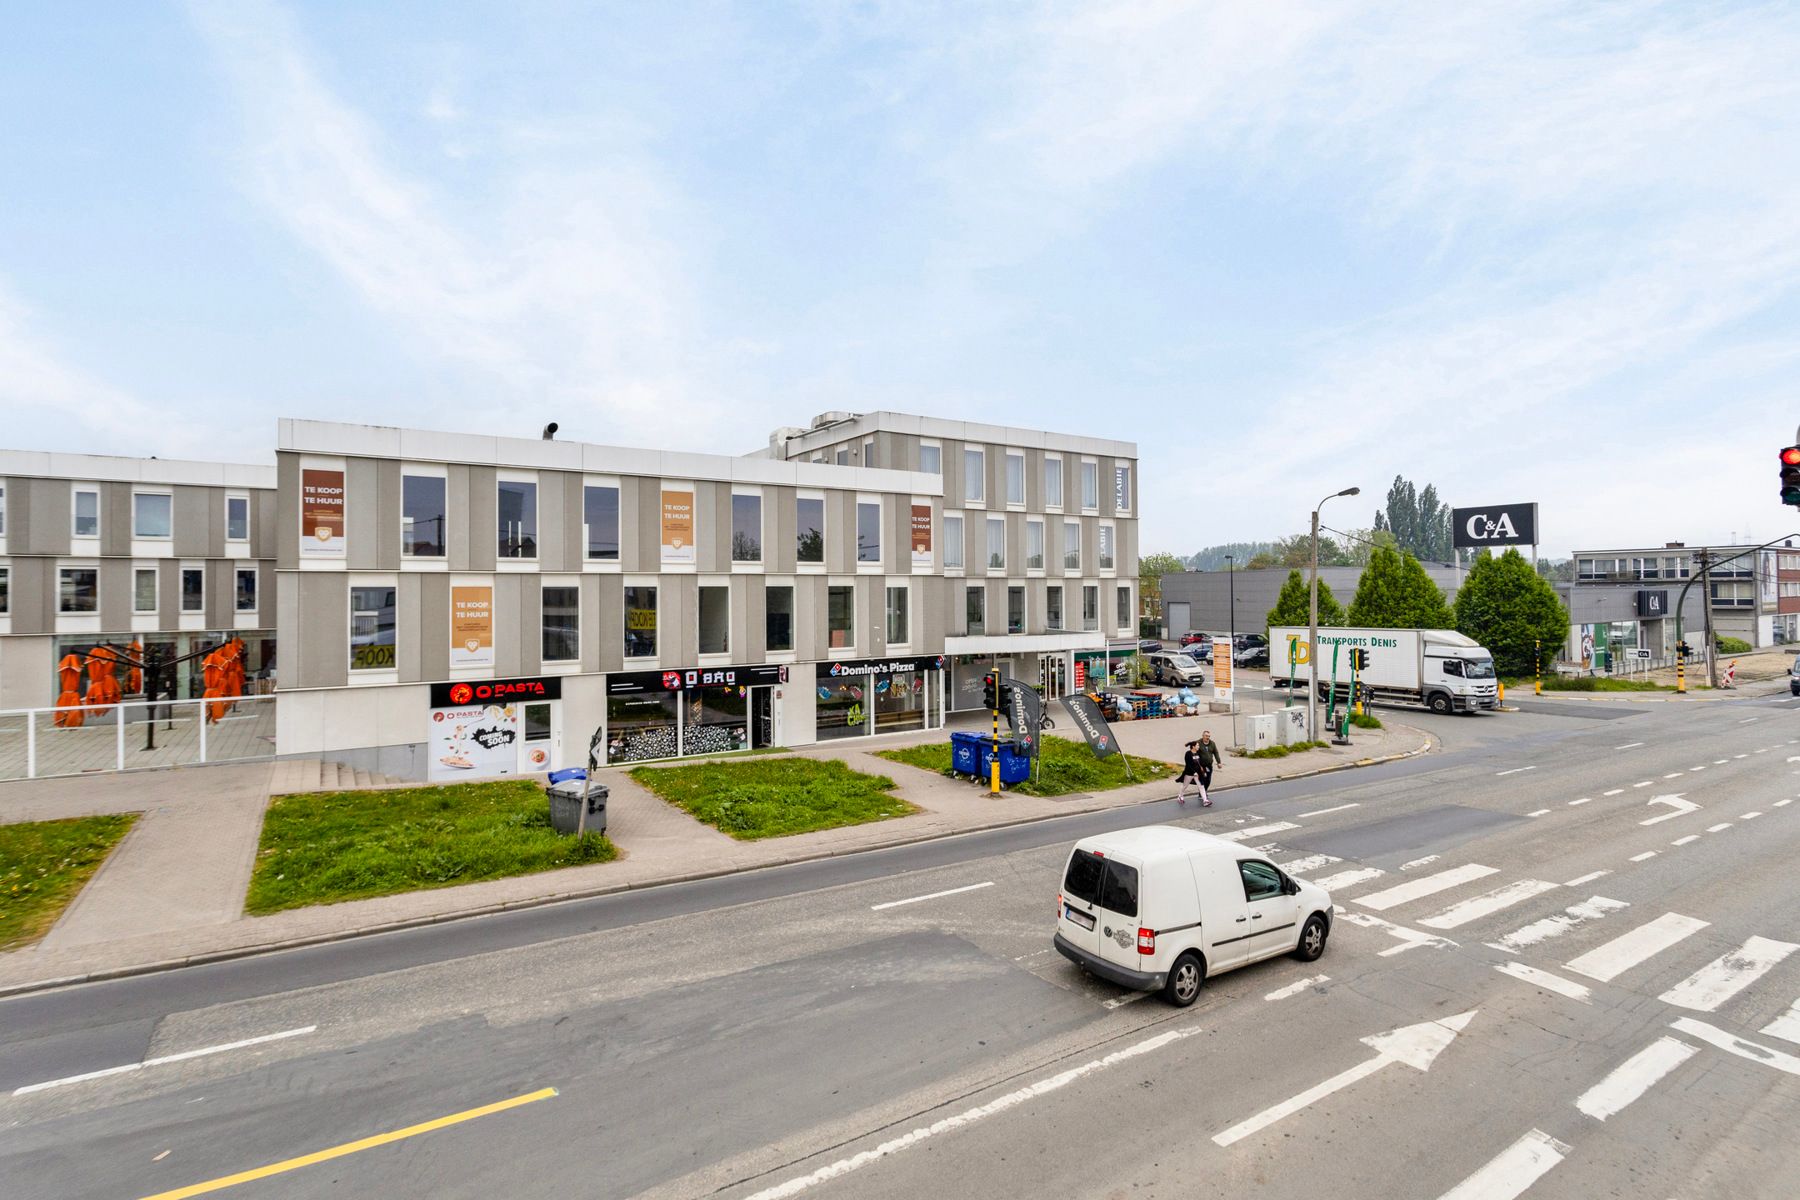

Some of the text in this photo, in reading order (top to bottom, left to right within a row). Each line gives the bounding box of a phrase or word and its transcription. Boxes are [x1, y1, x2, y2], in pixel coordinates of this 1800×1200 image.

[1466, 512, 1519, 539] C&A
[1650, 596, 1660, 610] C&A
[1317, 636, 1397, 648] TRANSPORTS DENIS
[841, 662, 914, 676] Domino's Pizza
[488, 736, 510, 746] SOON
